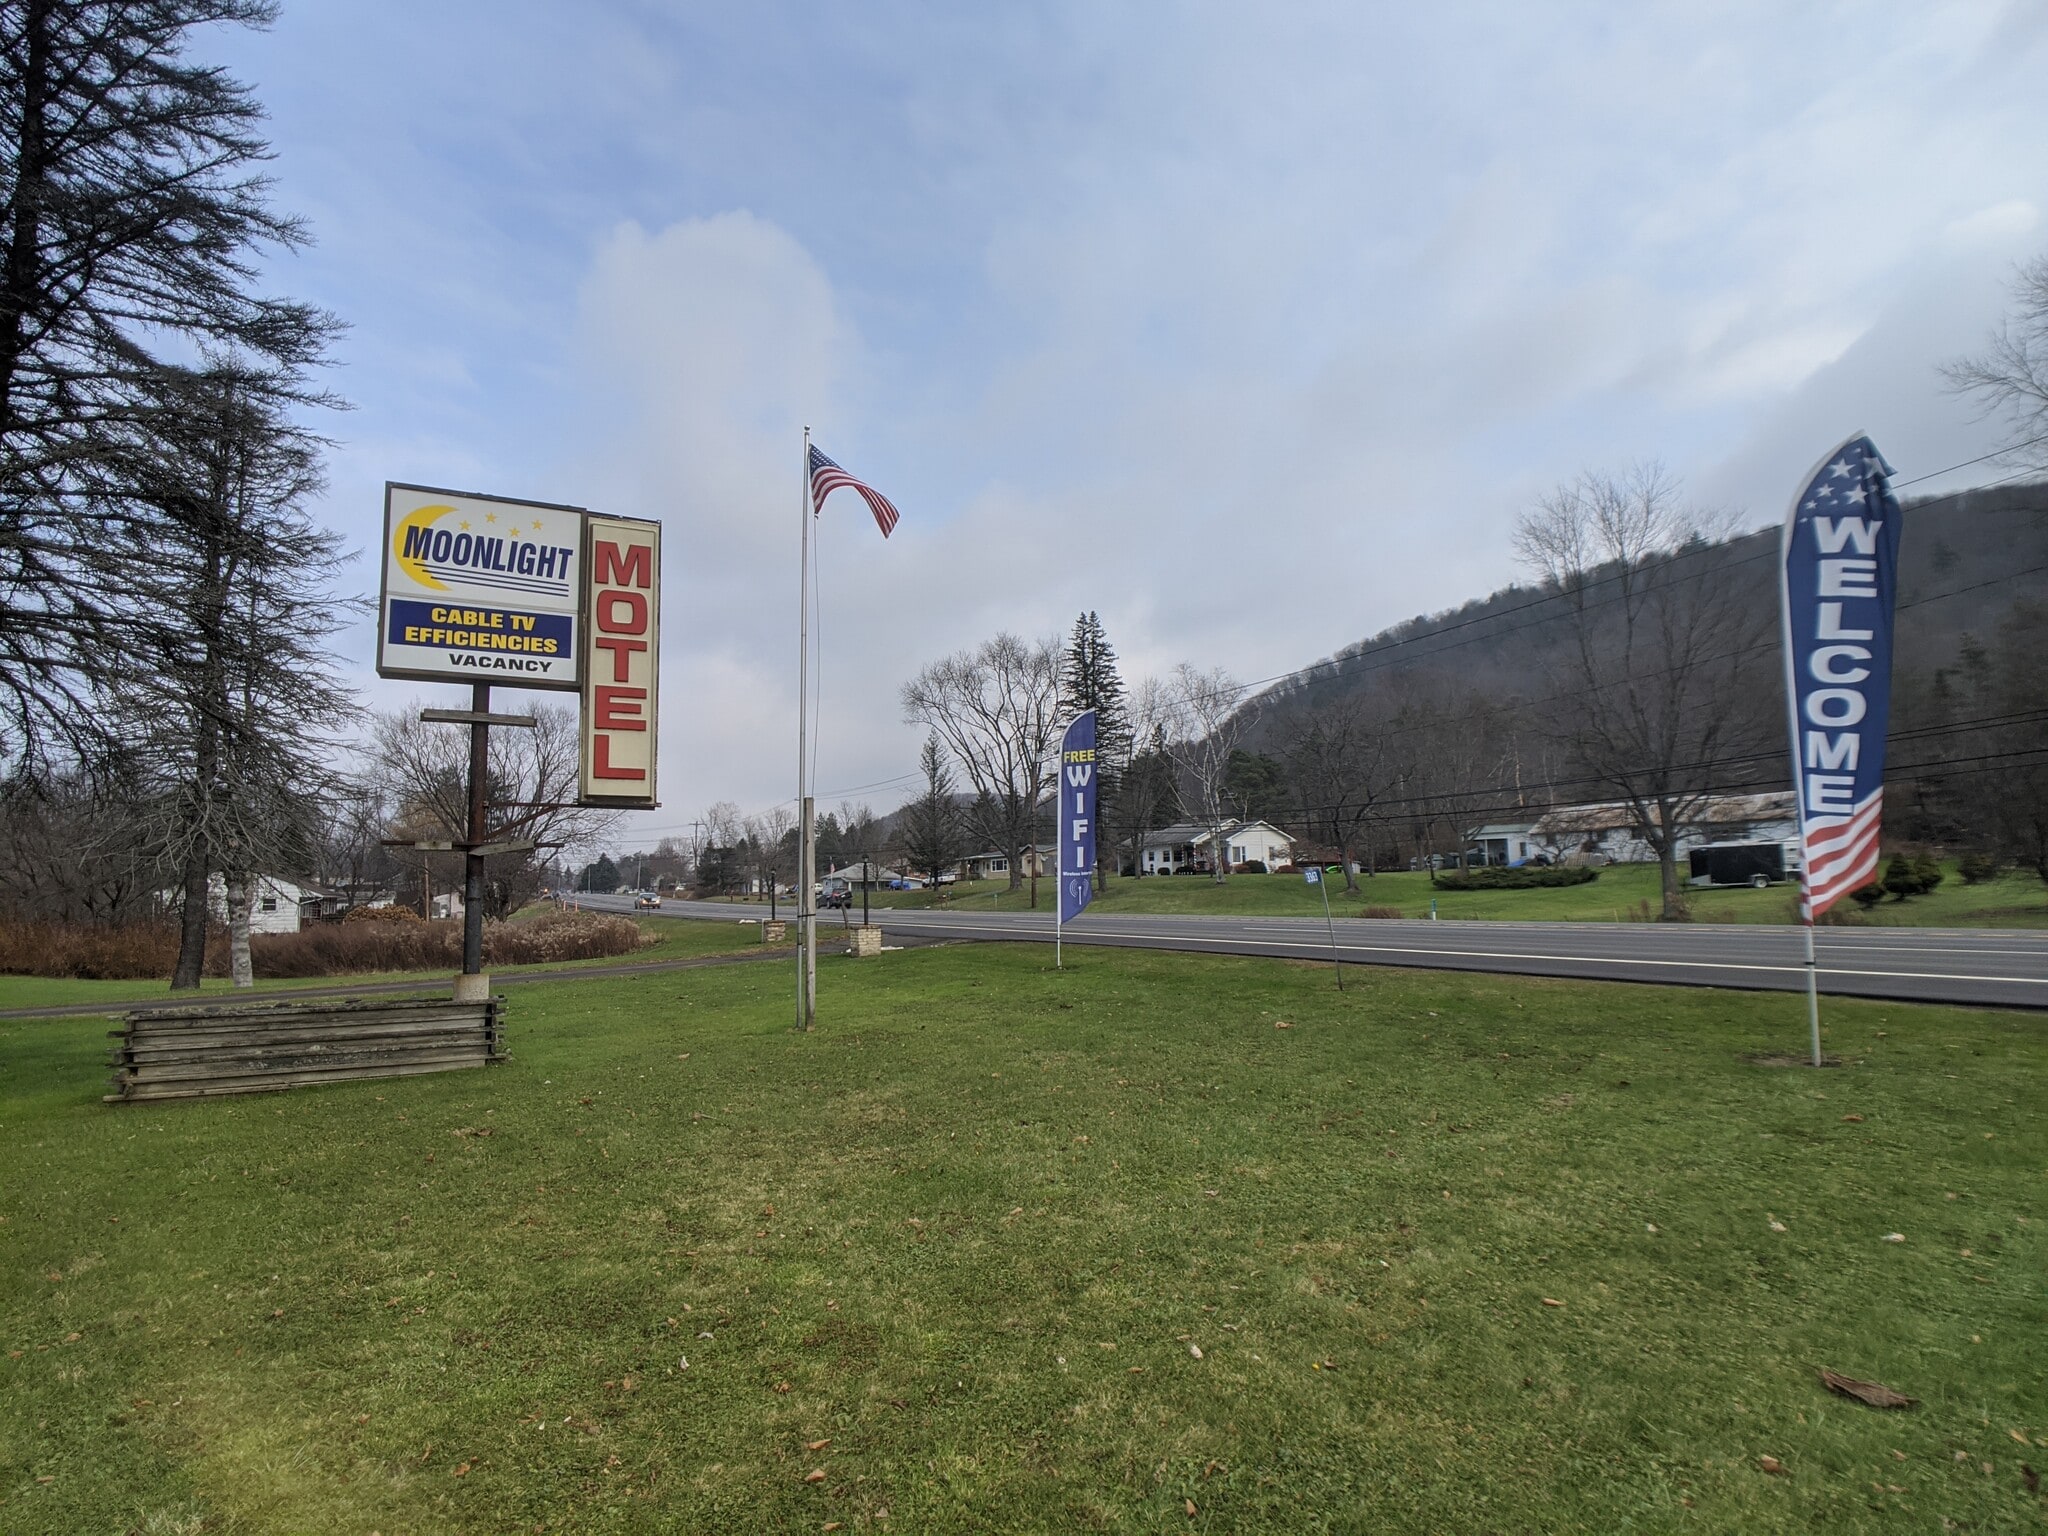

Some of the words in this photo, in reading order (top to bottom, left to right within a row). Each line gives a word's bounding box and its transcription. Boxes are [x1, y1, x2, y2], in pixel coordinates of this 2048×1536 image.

[403, 525, 573, 580] MOONLIGHT
[431, 607, 504, 628] CABLE
[510, 614, 536, 631] TV
[405, 626, 558, 653] EFFICIENCIES
[448, 653, 552, 672] VACANCY
[593, 540, 652, 780] MOTEL
[1805, 516, 1883, 816] WELCOME
[1064, 749, 1095, 763] FREE
